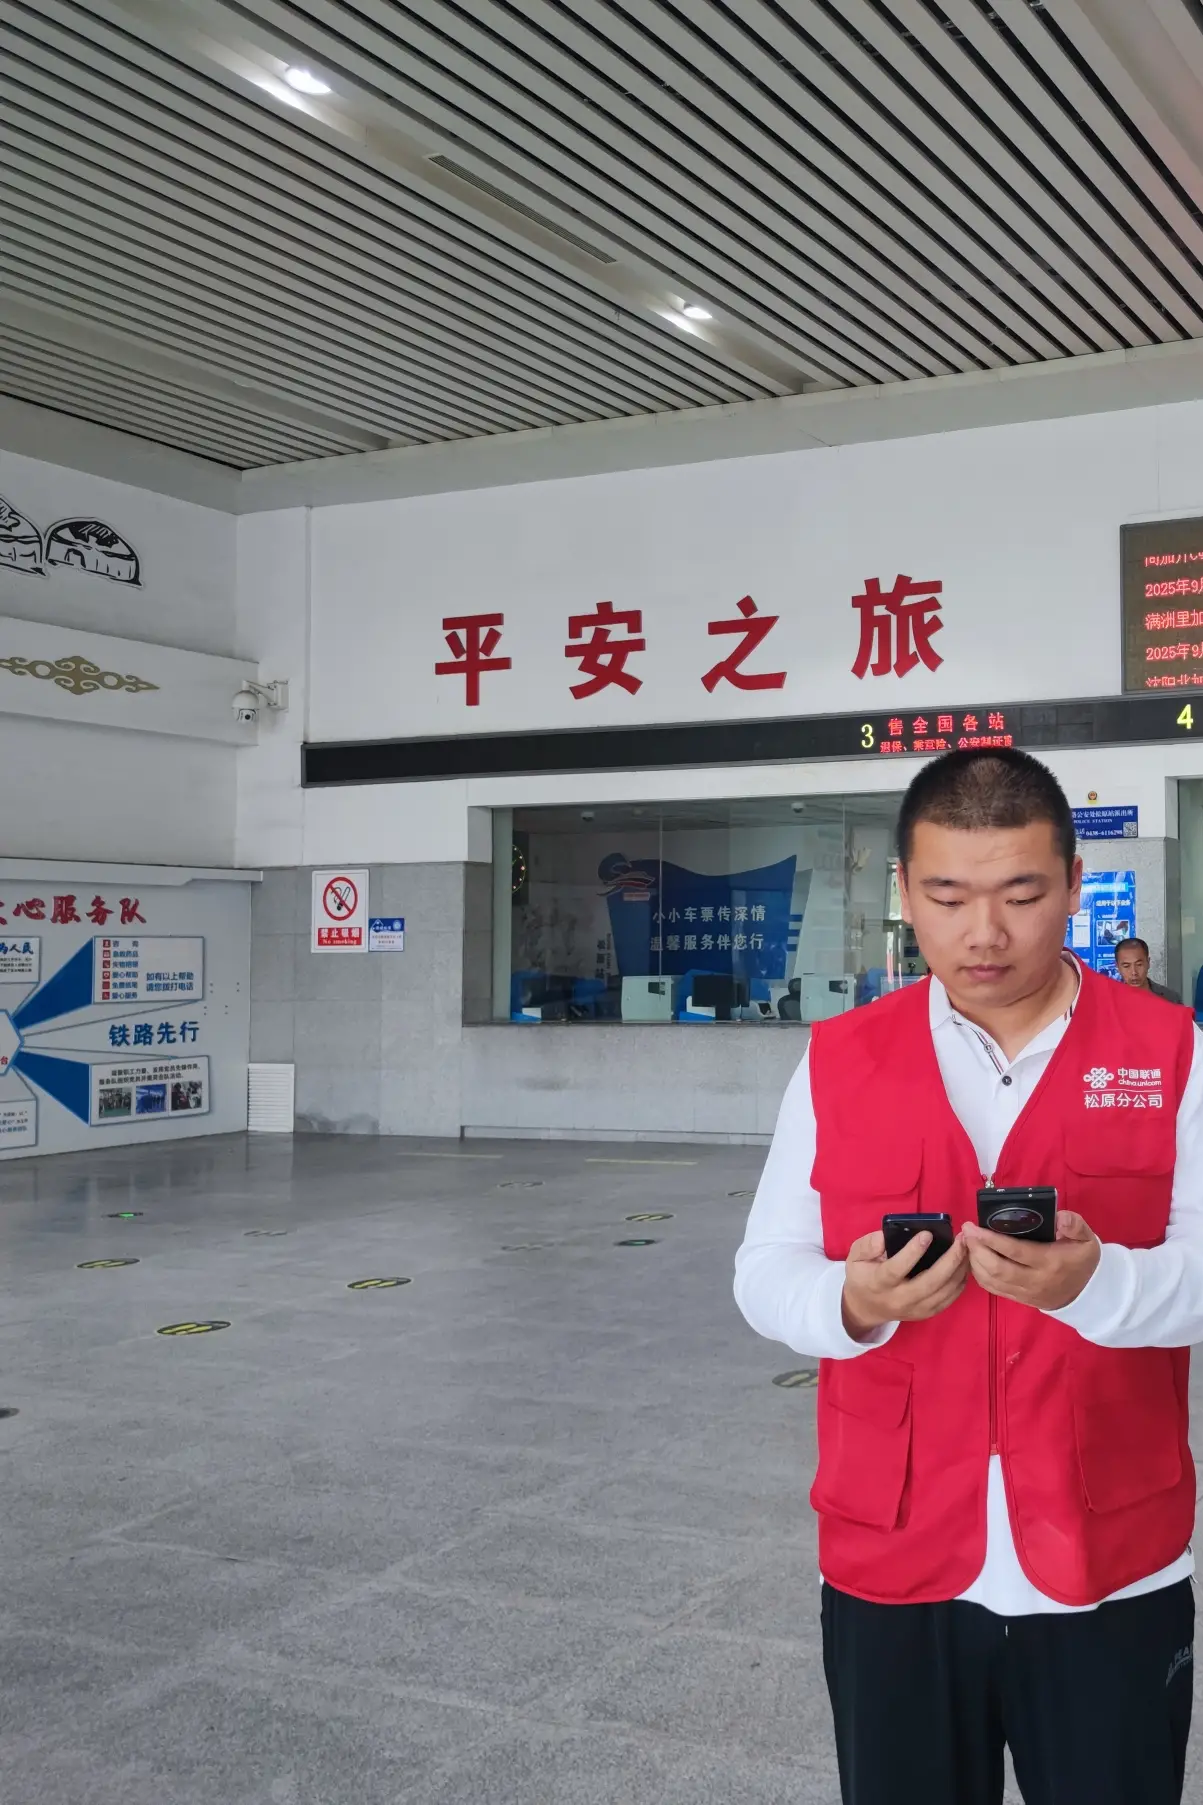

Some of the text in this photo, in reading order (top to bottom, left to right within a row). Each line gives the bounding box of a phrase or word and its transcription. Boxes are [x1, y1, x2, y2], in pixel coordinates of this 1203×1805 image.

[434, 573, 944, 706] 平安之旅
[887, 712, 1005, 737] 售全国各站
[1177, 704, 1194, 729] 4
[861, 723, 875, 749] 3
[0, 894, 147, 926] 心服务队
[652, 904, 766, 925] 小小车票传深情
[320, 927, 360, 938] 禁止吸烟
[650, 933, 765, 951] 温馨服务伴您行
[109, 1021, 200, 1047] 铁路先行
[1117, 1067, 1162, 1080] 中国联通
[1084, 1092, 1163, 1109] 松原分公司
